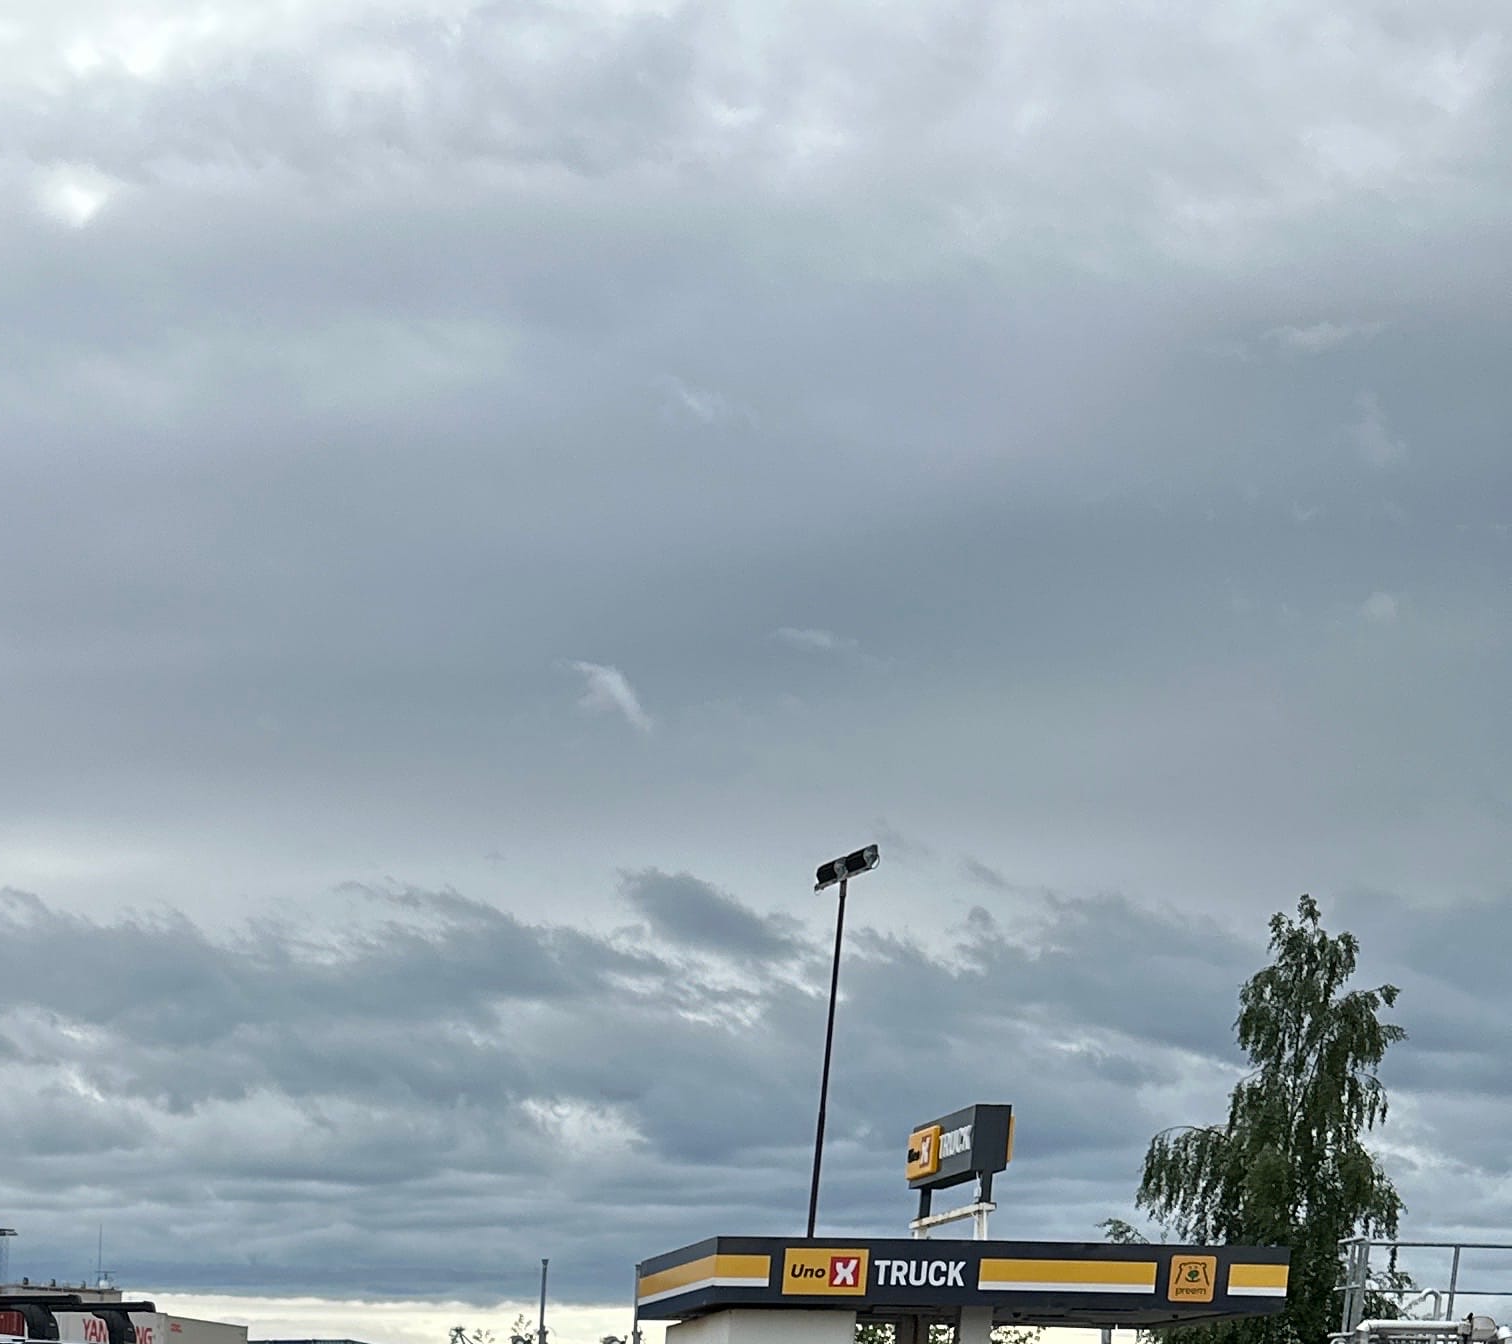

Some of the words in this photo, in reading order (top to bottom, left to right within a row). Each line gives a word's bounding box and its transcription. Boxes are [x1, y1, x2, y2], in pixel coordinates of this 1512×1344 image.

[939, 1124, 973, 1159] TRUCK
[791, 1264, 825, 1278] Uno
[833, 1259, 858, 1286] X
[874, 1260, 967, 1287] TRUCK
